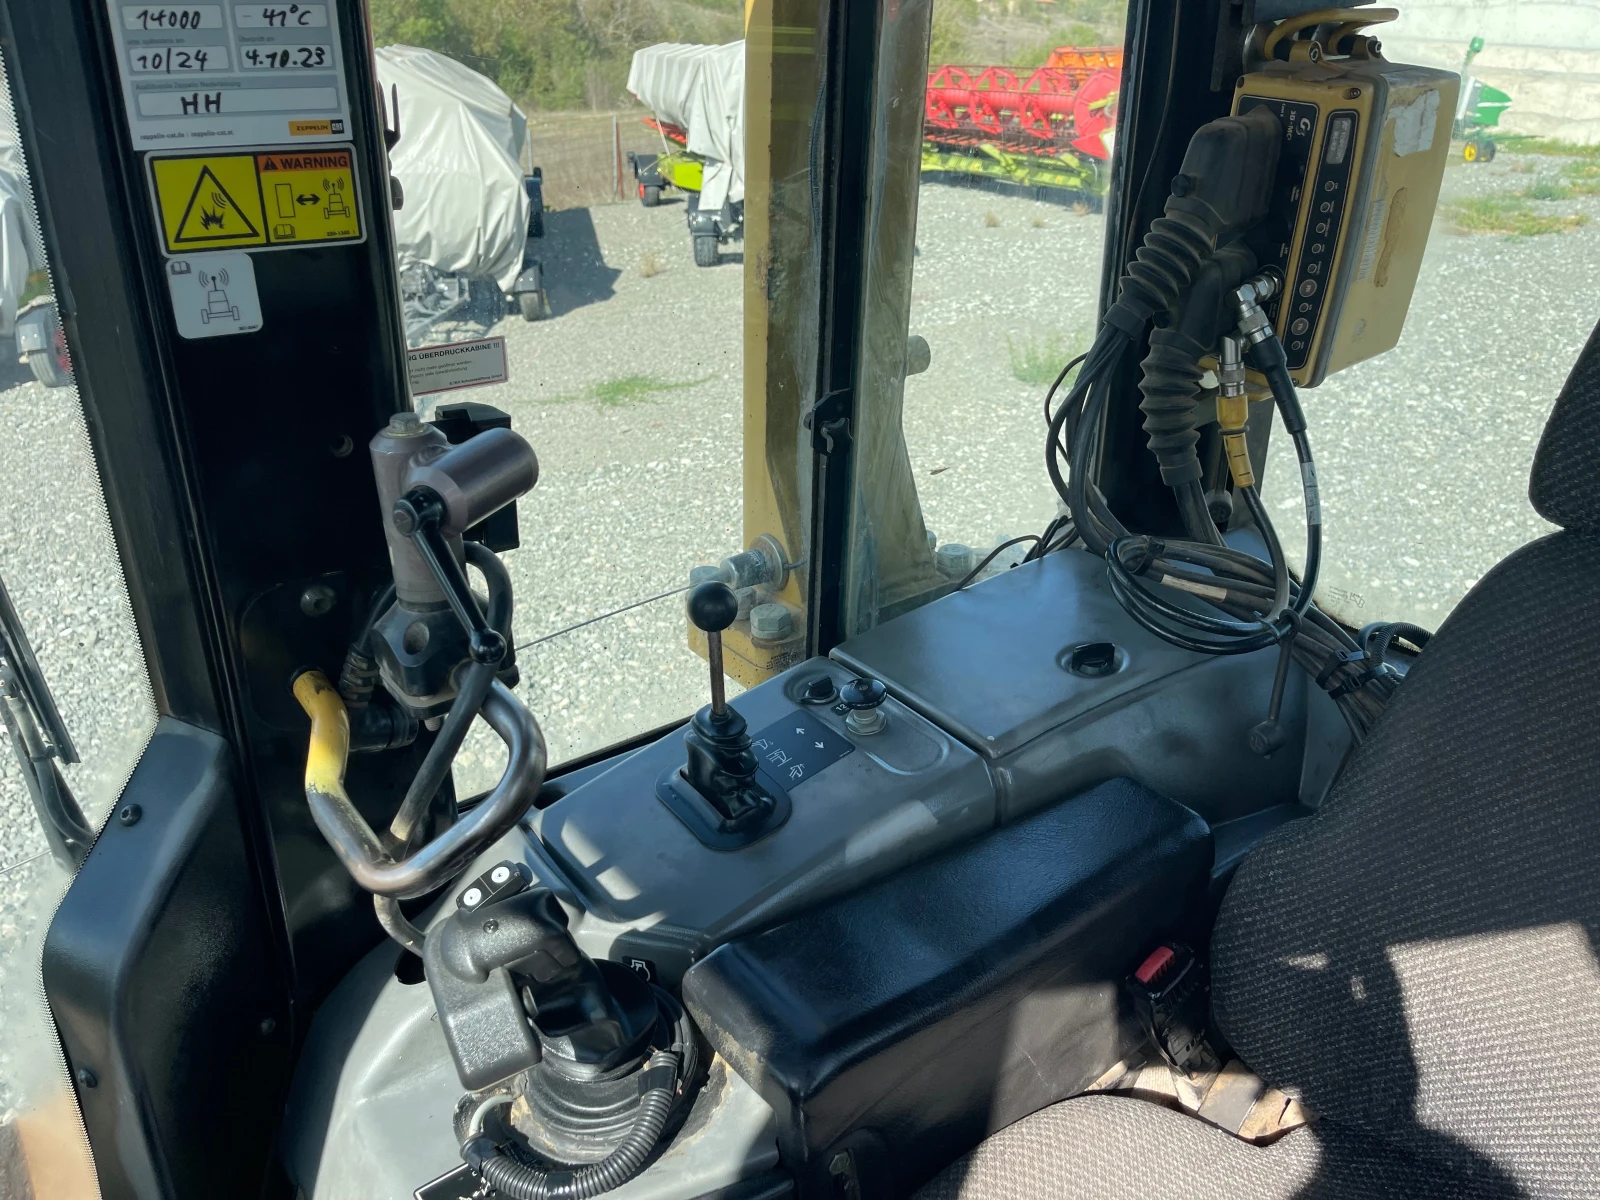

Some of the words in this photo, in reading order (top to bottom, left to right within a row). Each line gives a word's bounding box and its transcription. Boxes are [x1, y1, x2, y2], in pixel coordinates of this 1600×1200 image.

[136, 9, 202, 31] 14000
[245, 46, 326, 68] 4.10.23
[296, 124, 329, 132] ZEPPELIN
[280, 156, 348, 170] WARNING
[419, 343, 492, 360] ÜBERDRUCKKABINE
